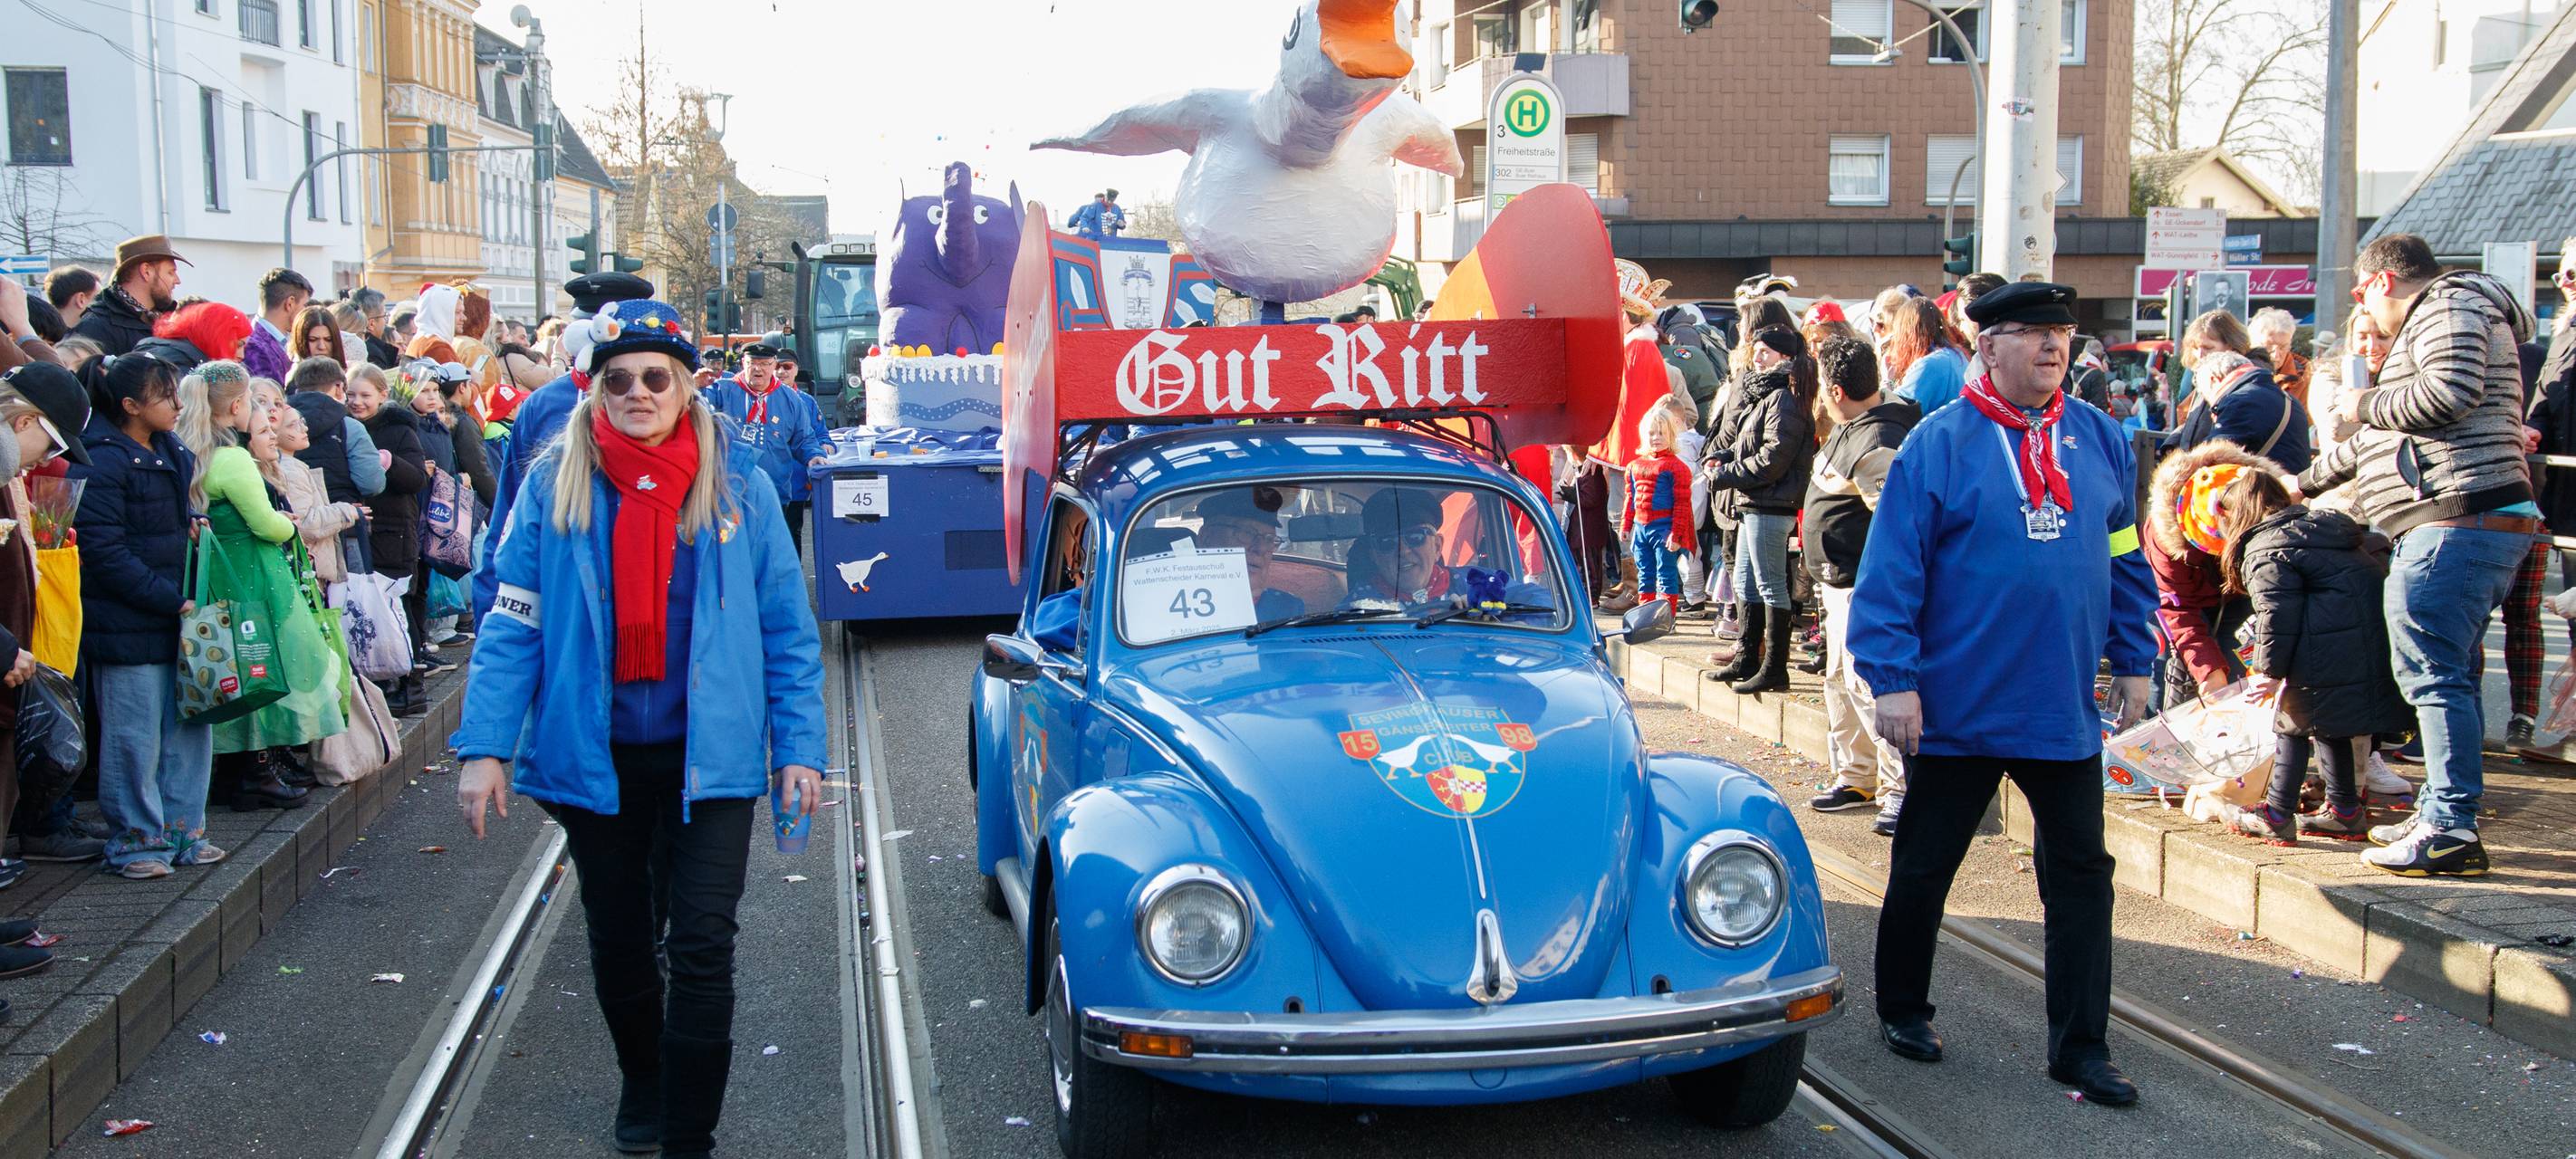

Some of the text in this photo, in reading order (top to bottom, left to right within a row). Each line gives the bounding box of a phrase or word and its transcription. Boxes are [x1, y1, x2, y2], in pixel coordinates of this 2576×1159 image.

[1517, 101, 1538, 127] H
[1496, 124, 1505, 138] 3
[1497, 146, 1555, 157] Freiheitstraße
[1495, 168, 1512, 177] 302
[2248, 269, 2278, 292] ode
[1116, 329, 1281, 416] Gut
[1312, 323, 1488, 409] Ritt
[852, 493, 872, 506] 45
[1173, 562, 1225, 572] Festausschuß
[1133, 574, 1192, 586] Wattenscheider
[1195, 571, 1227, 580] Karneval
[1169, 588, 1216, 618] 43
[1344, 733, 1376, 753] 15
[1501, 726, 1533, 744] 98
